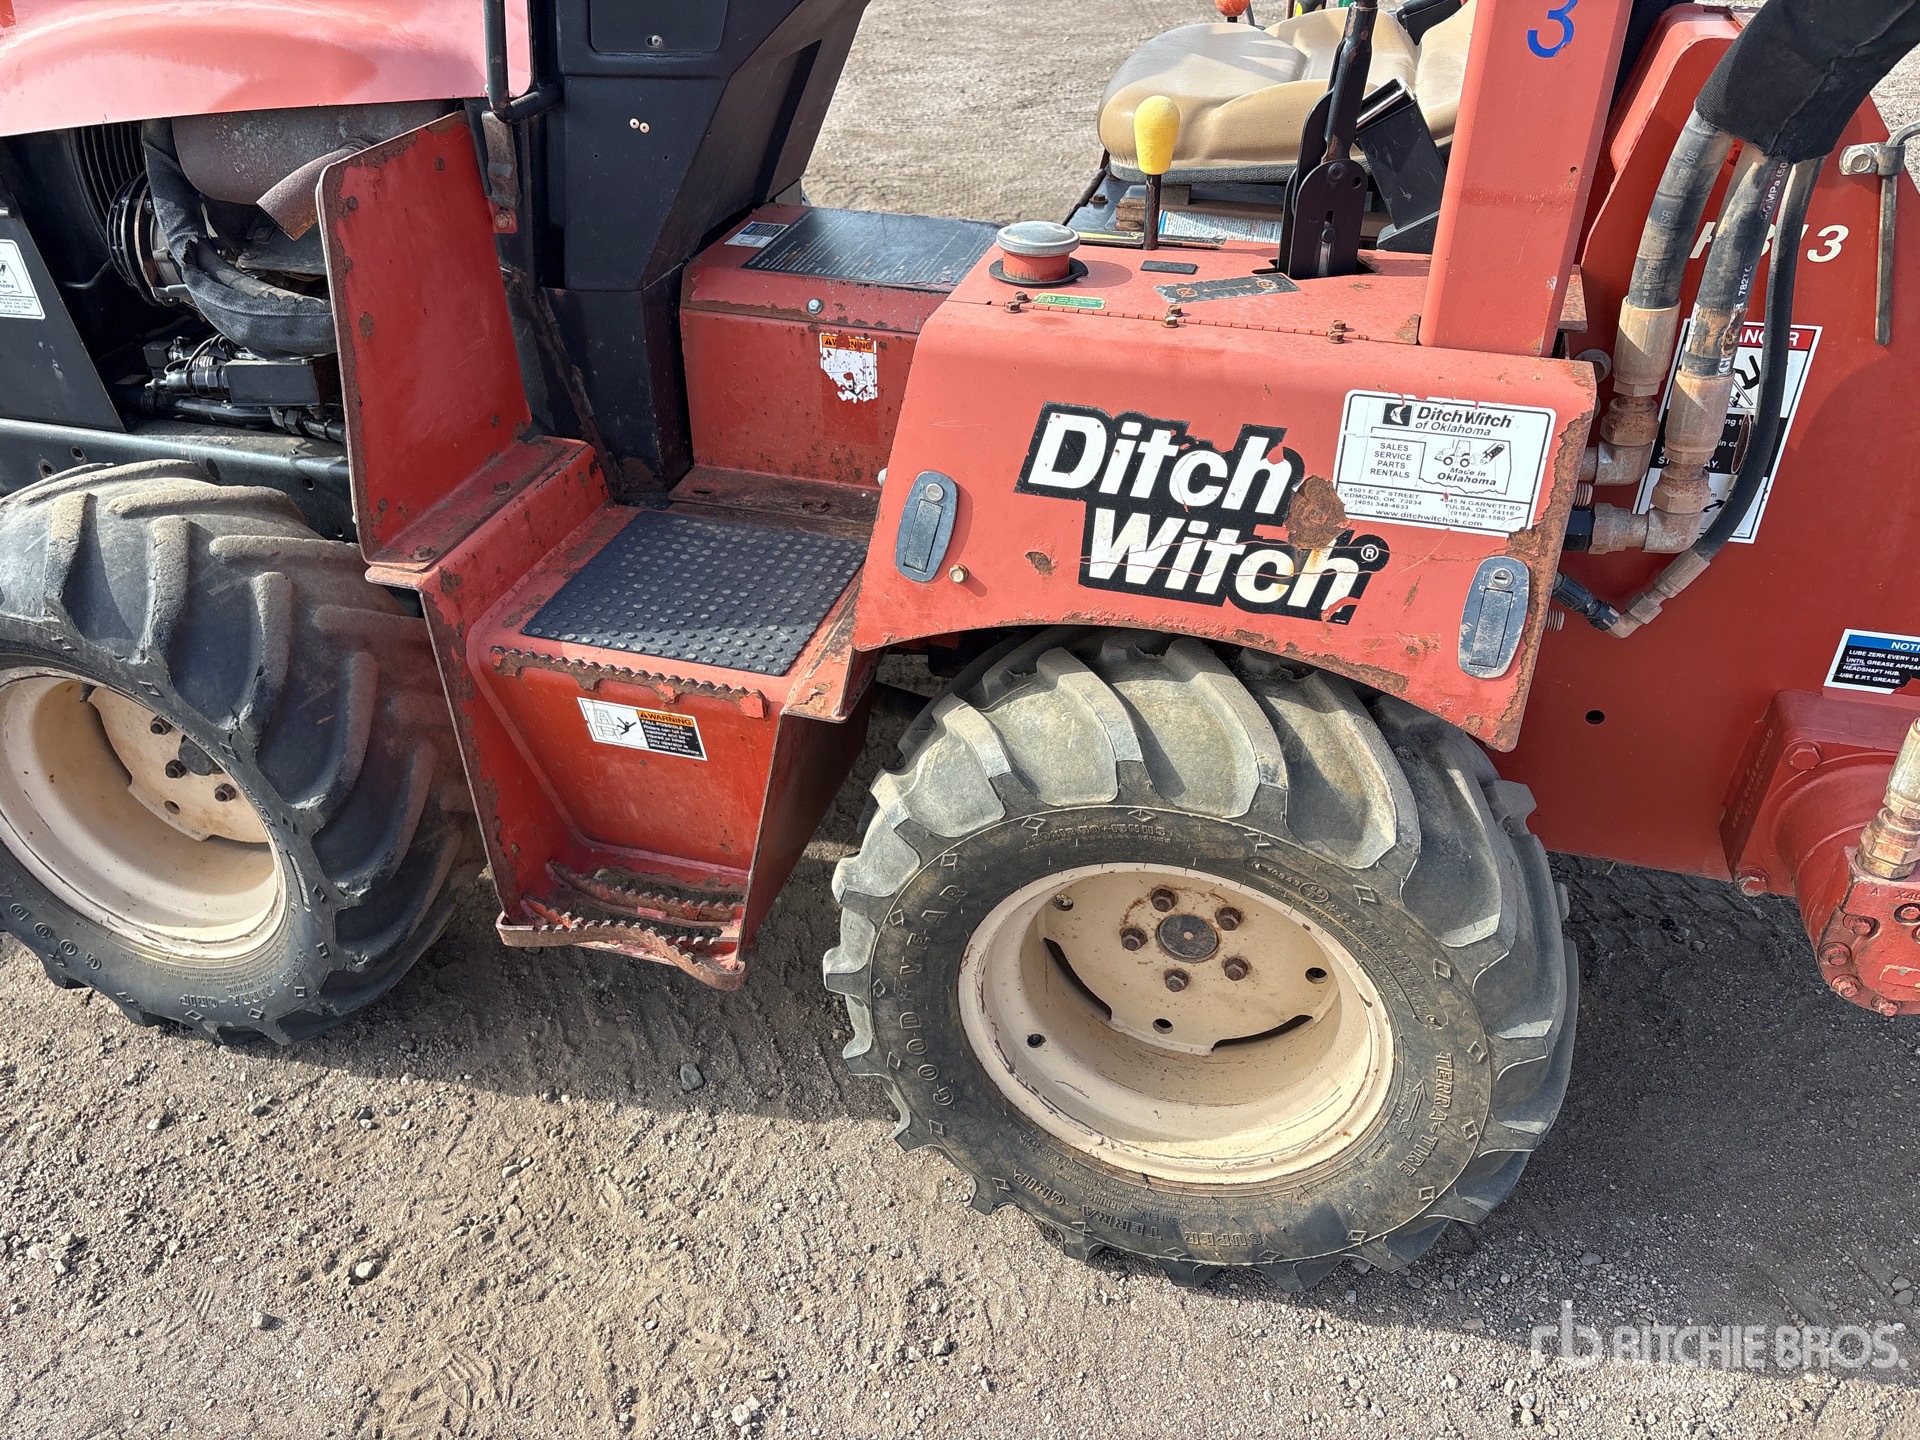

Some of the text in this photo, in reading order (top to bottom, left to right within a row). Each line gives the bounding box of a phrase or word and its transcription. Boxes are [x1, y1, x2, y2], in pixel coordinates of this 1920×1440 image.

[1527, 0, 1578, 58] 3
[1415, 420, 1491, 436] of Oklahoma
[1379, 442, 1409, 452] SALES
[1373, 450, 1413, 461] SERVICE
[1027, 412, 1293, 515] Ditch
[1376, 459, 1406, 470] PARTS
[1369, 468, 1410, 479] RENTALS
[1449, 467, 1486, 477] Made in
[1437, 472, 1497, 487] Oklahoma
[1344, 492, 1382, 502] EDMOND,
[1399, 498, 1422, 506] 73034
[1388, 491, 1420, 500] STREET
[1354, 499, 1410, 510] (405) 348-4633
[1468, 500, 1508, 510] GARNETT
[1444, 504, 1474, 513] TULSA,
[1492, 509, 1515, 517] 74116
[1450, 510, 1506, 521] (918) 438-1560
[1375, 509, 1483, 527] www.ditchwitchok.com
[1890, 641, 1920, 652] NOTI
[1848, 649, 1868, 657] LUBE
[1867, 651, 1887, 659] ZERK
[1886, 653, 1910, 662] EVERY
[1842, 665, 1883, 674] HEADSHAFT
[1866, 660, 1896, 668] GREASE
[647, 713, 692, 726] WARNING
[1397, 1052, 1454, 1177] TERRA-TIRE
[1184, 1231, 1266, 1248] SUPER
